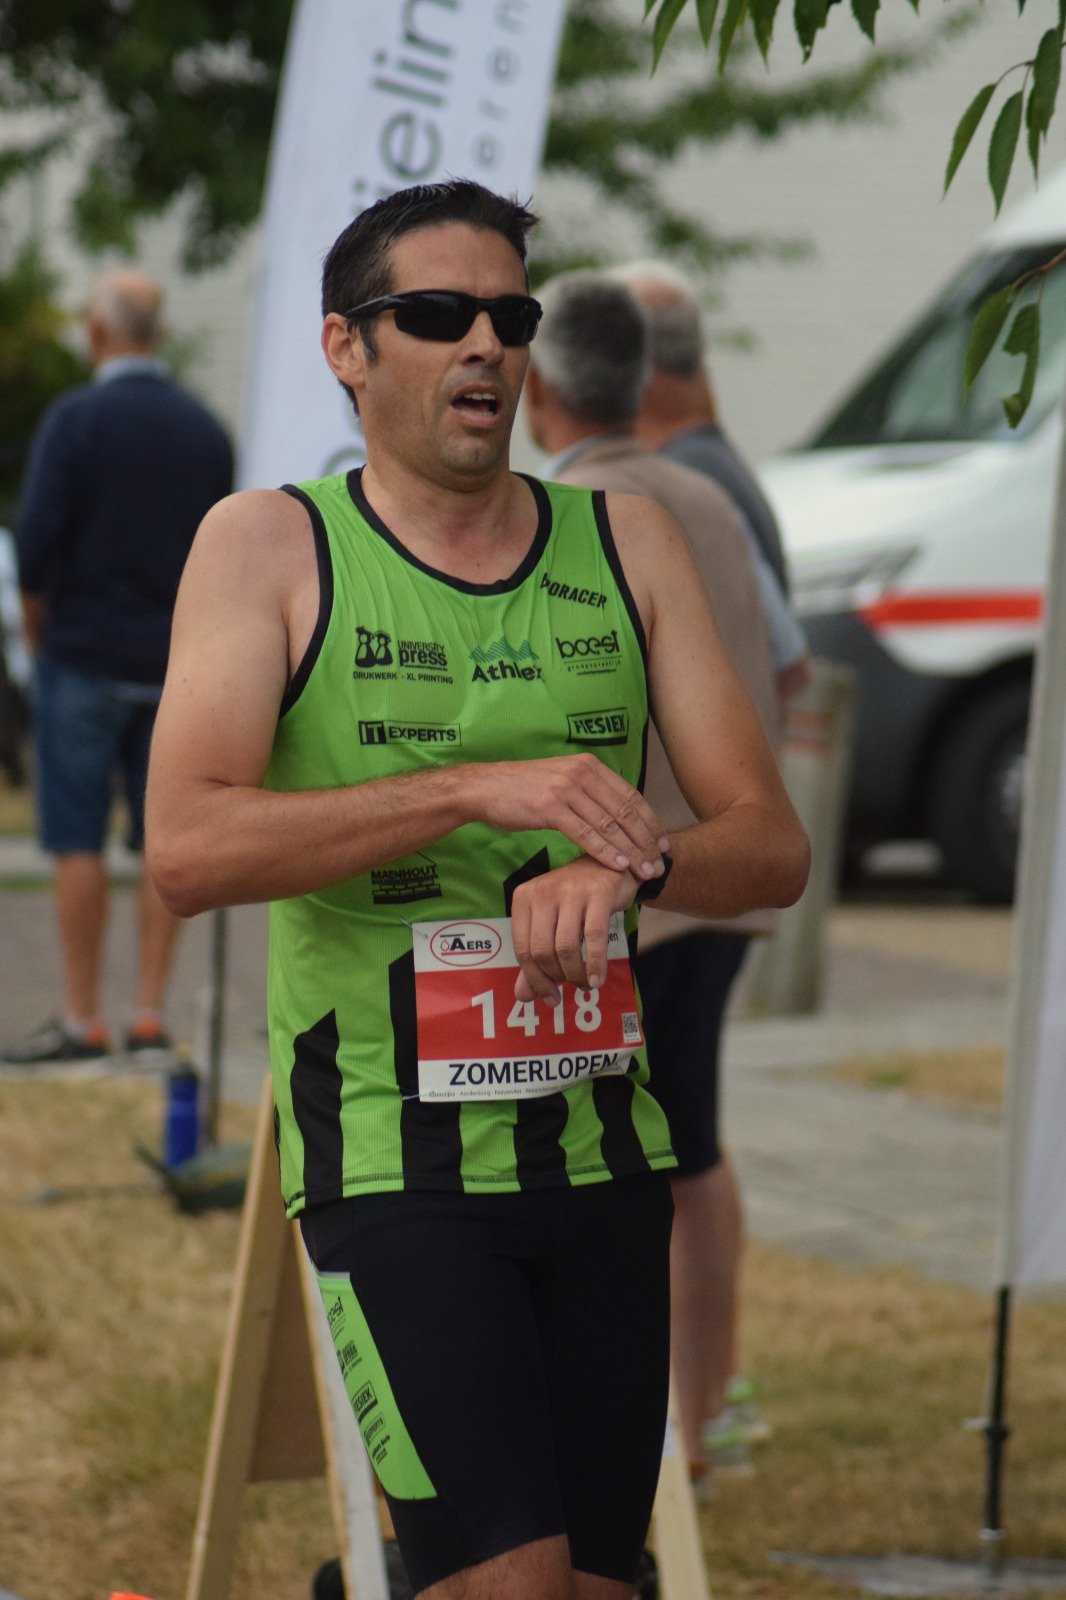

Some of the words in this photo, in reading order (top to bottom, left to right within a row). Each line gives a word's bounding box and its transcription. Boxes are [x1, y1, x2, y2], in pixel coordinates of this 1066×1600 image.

[398, 649, 448, 667] press
[352, 671, 397, 680] DRUKWERK
[388, 726, 456, 742] EXPERTS
[471, 985, 602, 1040] 1418
[449, 1053, 618, 1087] ZOMERLOPEN
